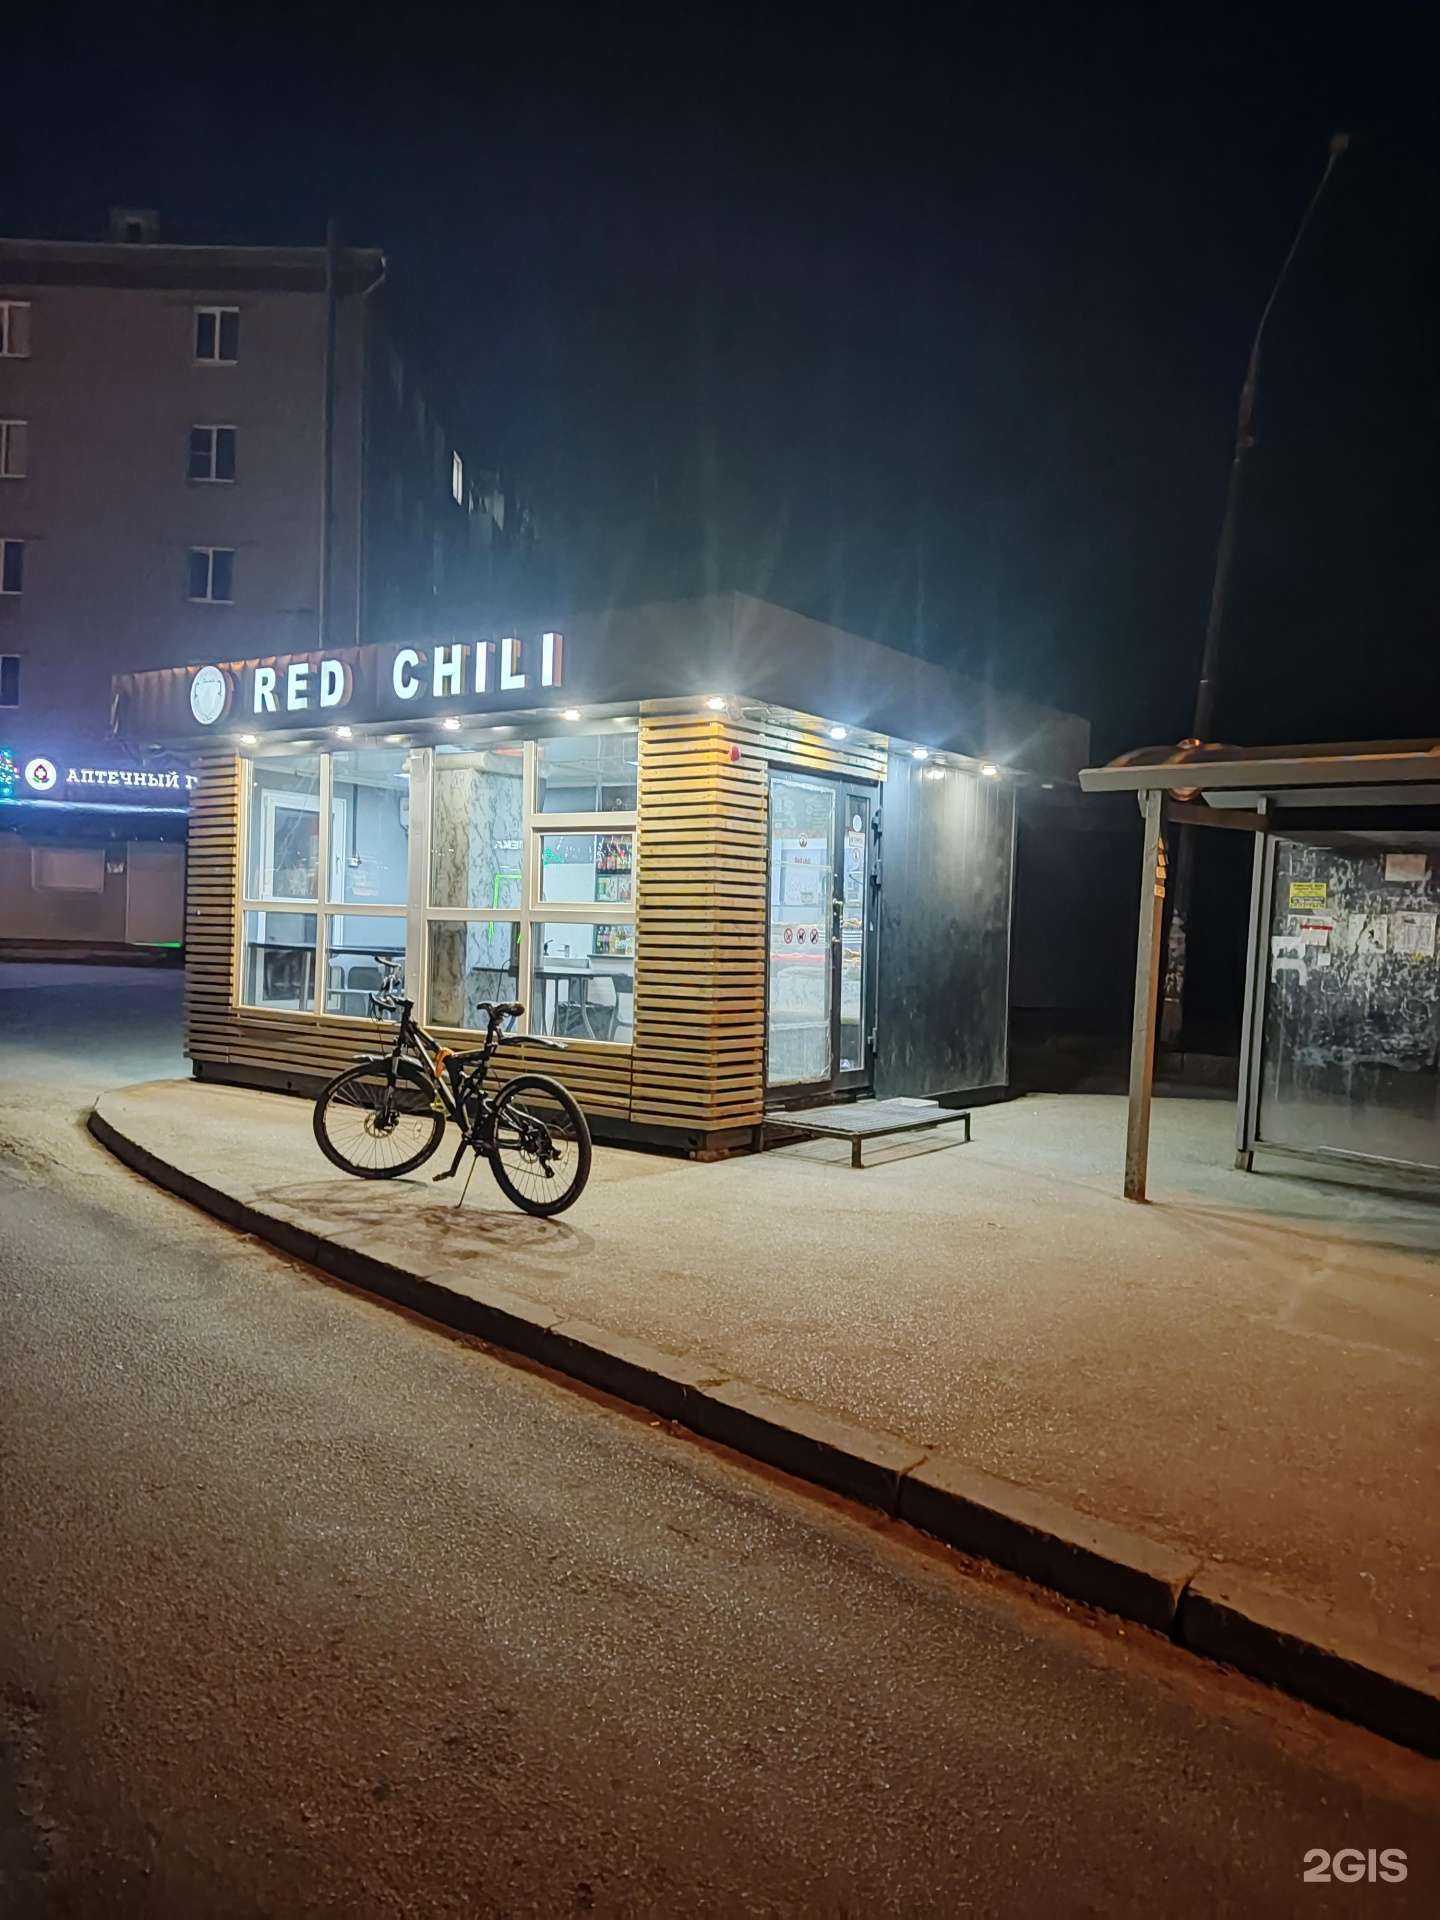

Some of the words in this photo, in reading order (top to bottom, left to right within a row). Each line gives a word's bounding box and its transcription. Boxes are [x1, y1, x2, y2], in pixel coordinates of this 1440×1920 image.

[254, 659, 347, 714] RED
[393, 632, 560, 700] CHILI
[66, 768, 180, 789] АПТЕЧНЫЙ
